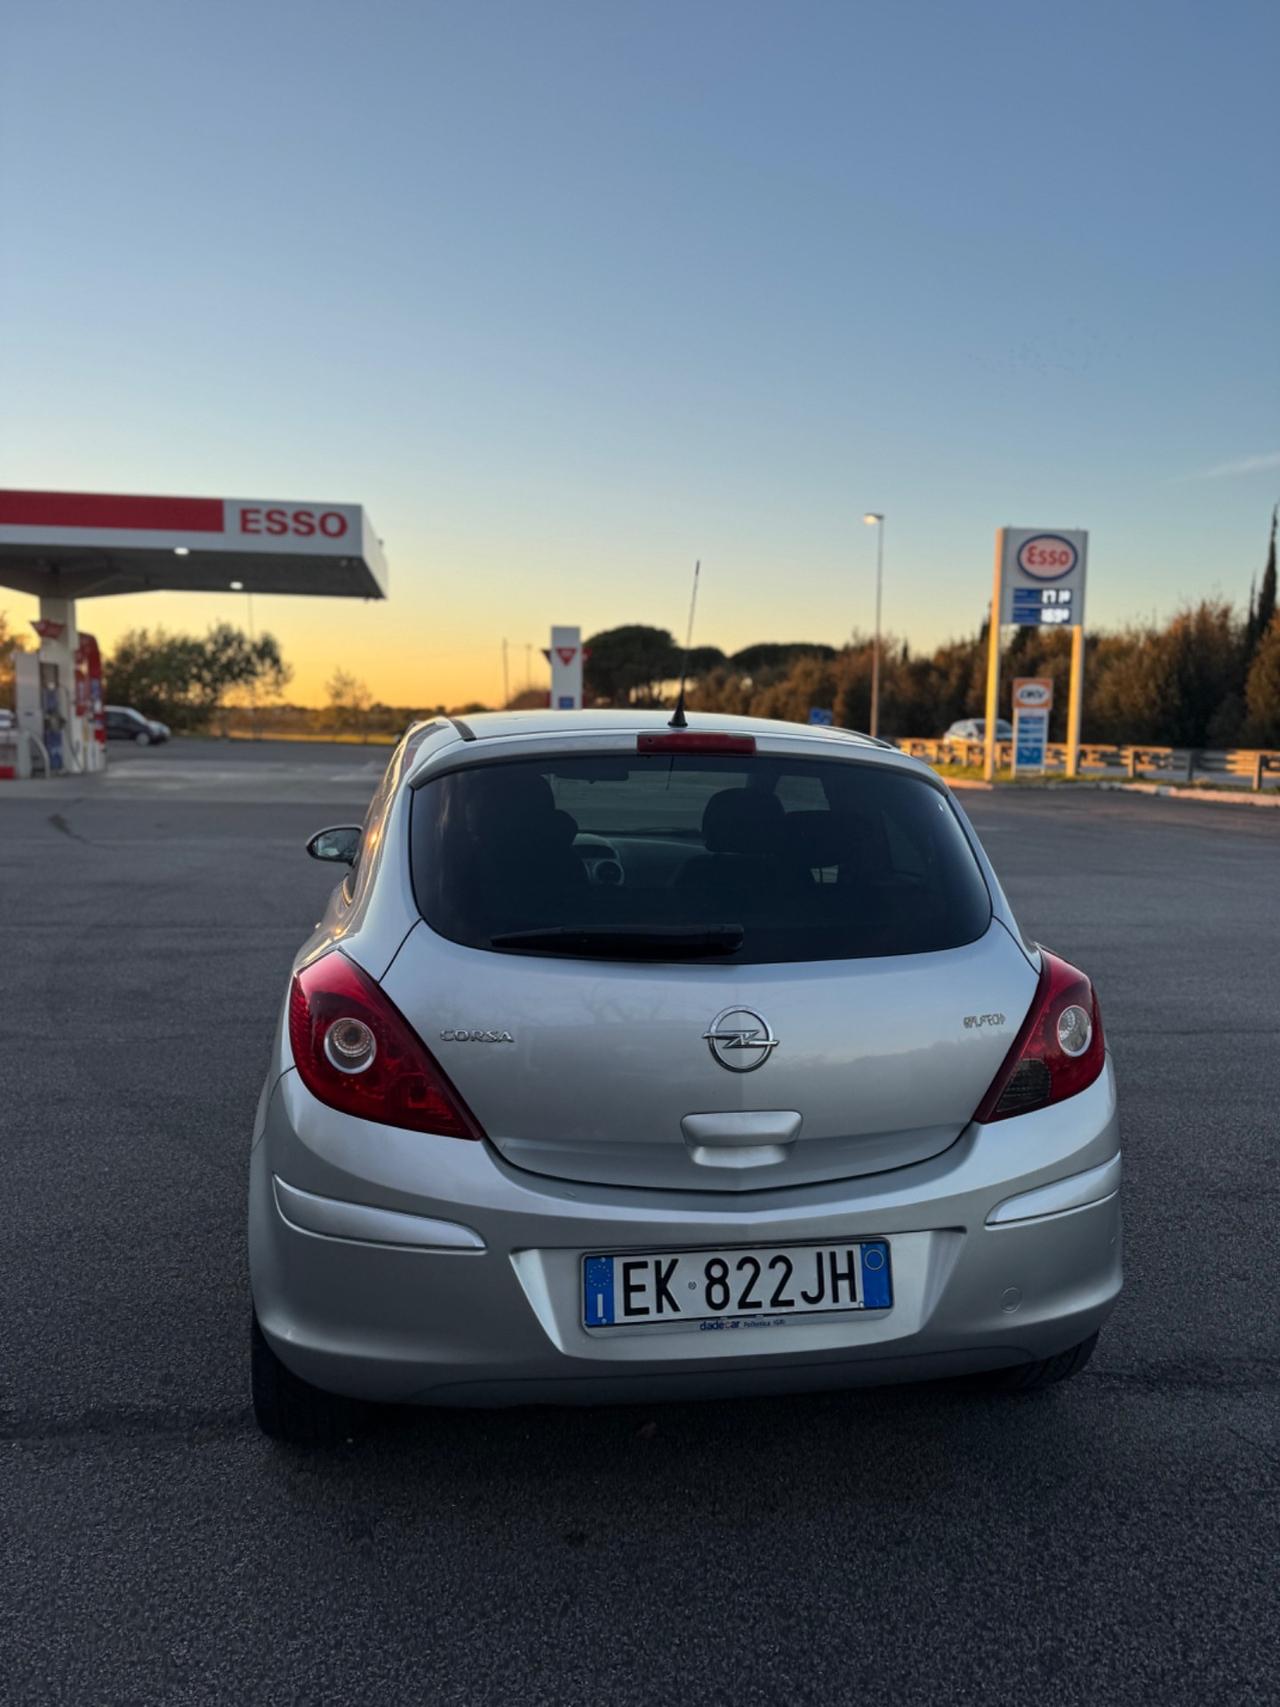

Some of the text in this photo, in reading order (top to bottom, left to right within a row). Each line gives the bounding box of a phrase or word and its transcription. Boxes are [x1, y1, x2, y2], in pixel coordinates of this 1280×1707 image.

[239, 508, 348, 539] ESSO
[1027, 545, 1070, 566] Esso
[440, 1030, 514, 1043] CORSA
[622, 1250, 859, 1316] EK 822JH
